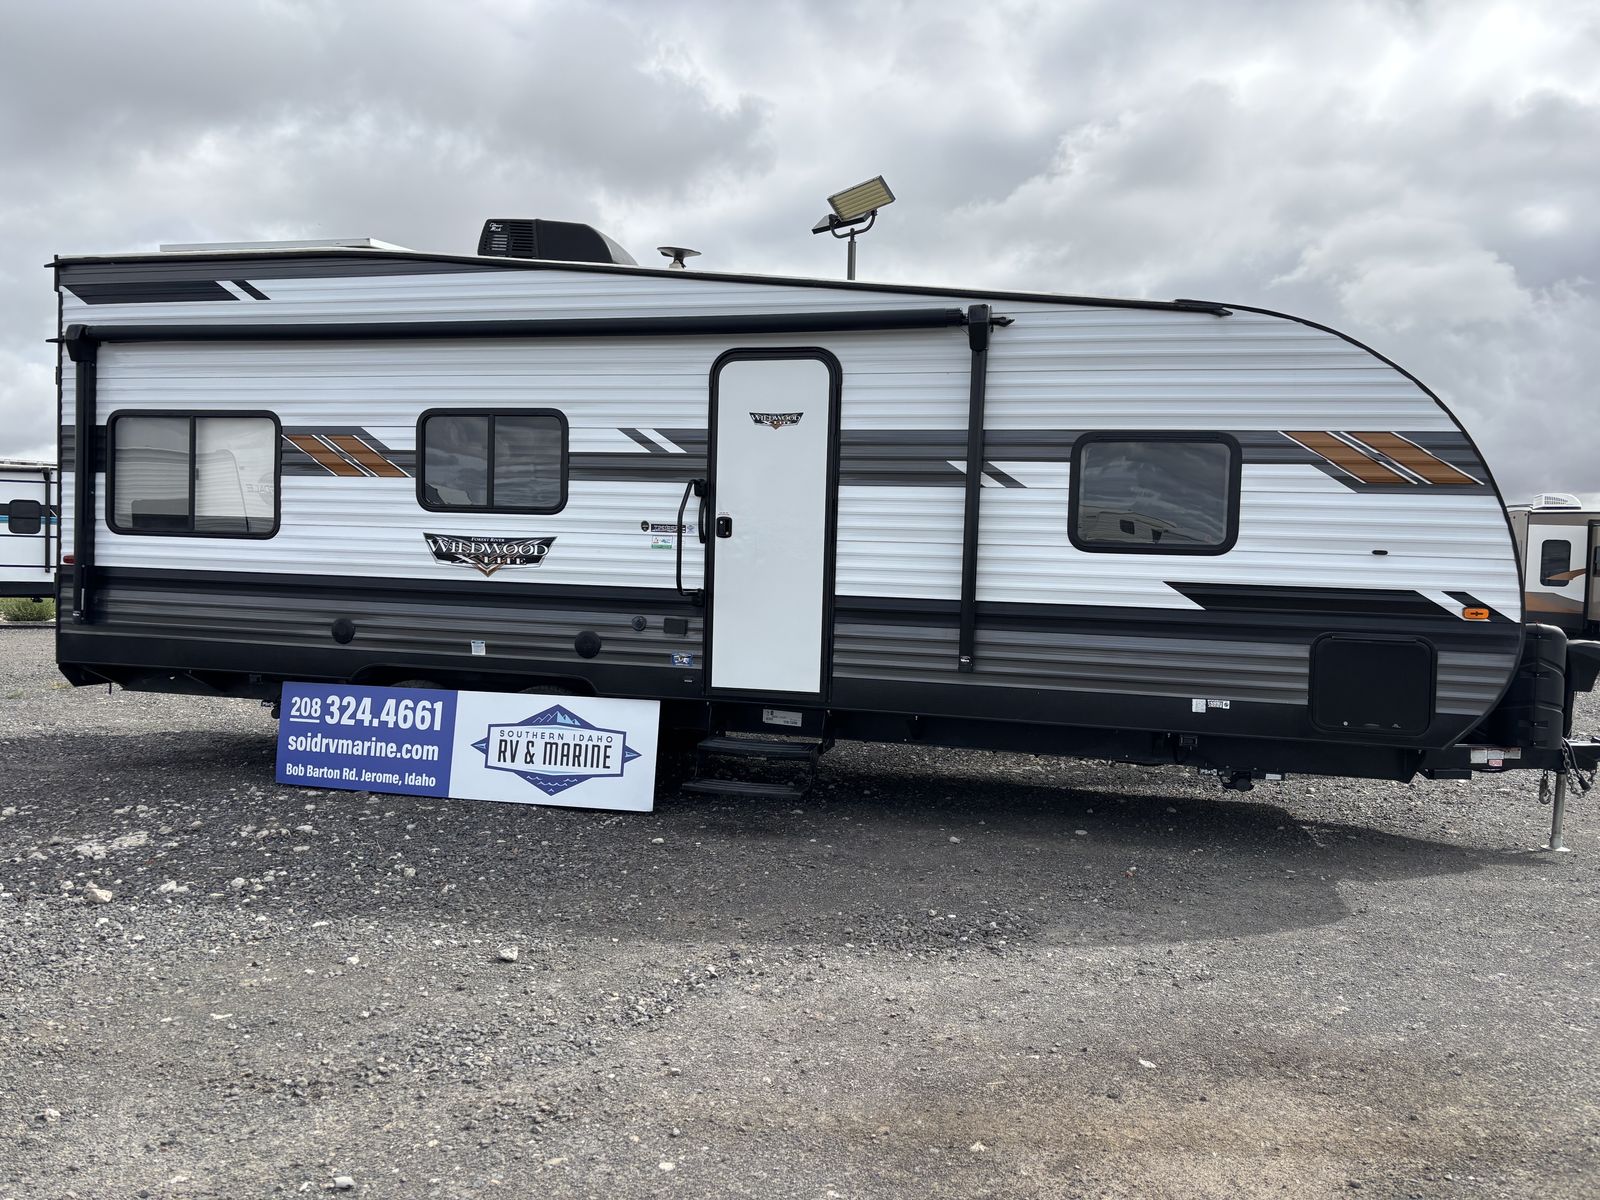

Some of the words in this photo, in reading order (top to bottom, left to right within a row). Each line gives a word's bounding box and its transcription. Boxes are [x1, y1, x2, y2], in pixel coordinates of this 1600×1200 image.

[426, 539, 549, 556] WILDWOOD
[290, 697, 321, 718] 208
[325, 695, 443, 731] 324.4661
[288, 733, 439, 761] soidrvmarine.com
[499, 729, 565, 741] SOUTHERN
[573, 733, 613, 744] IDAHO
[497, 739, 520, 763] RV
[524, 740, 536, 765] &
[542, 741, 612, 769] MARINE
[286, 763, 305, 777] Bob
[306, 765, 340, 779] Barton
[343, 767, 359, 781] Rd.
[360, 769, 402, 786] Jerome,
[404, 773, 436, 787] Idaho
